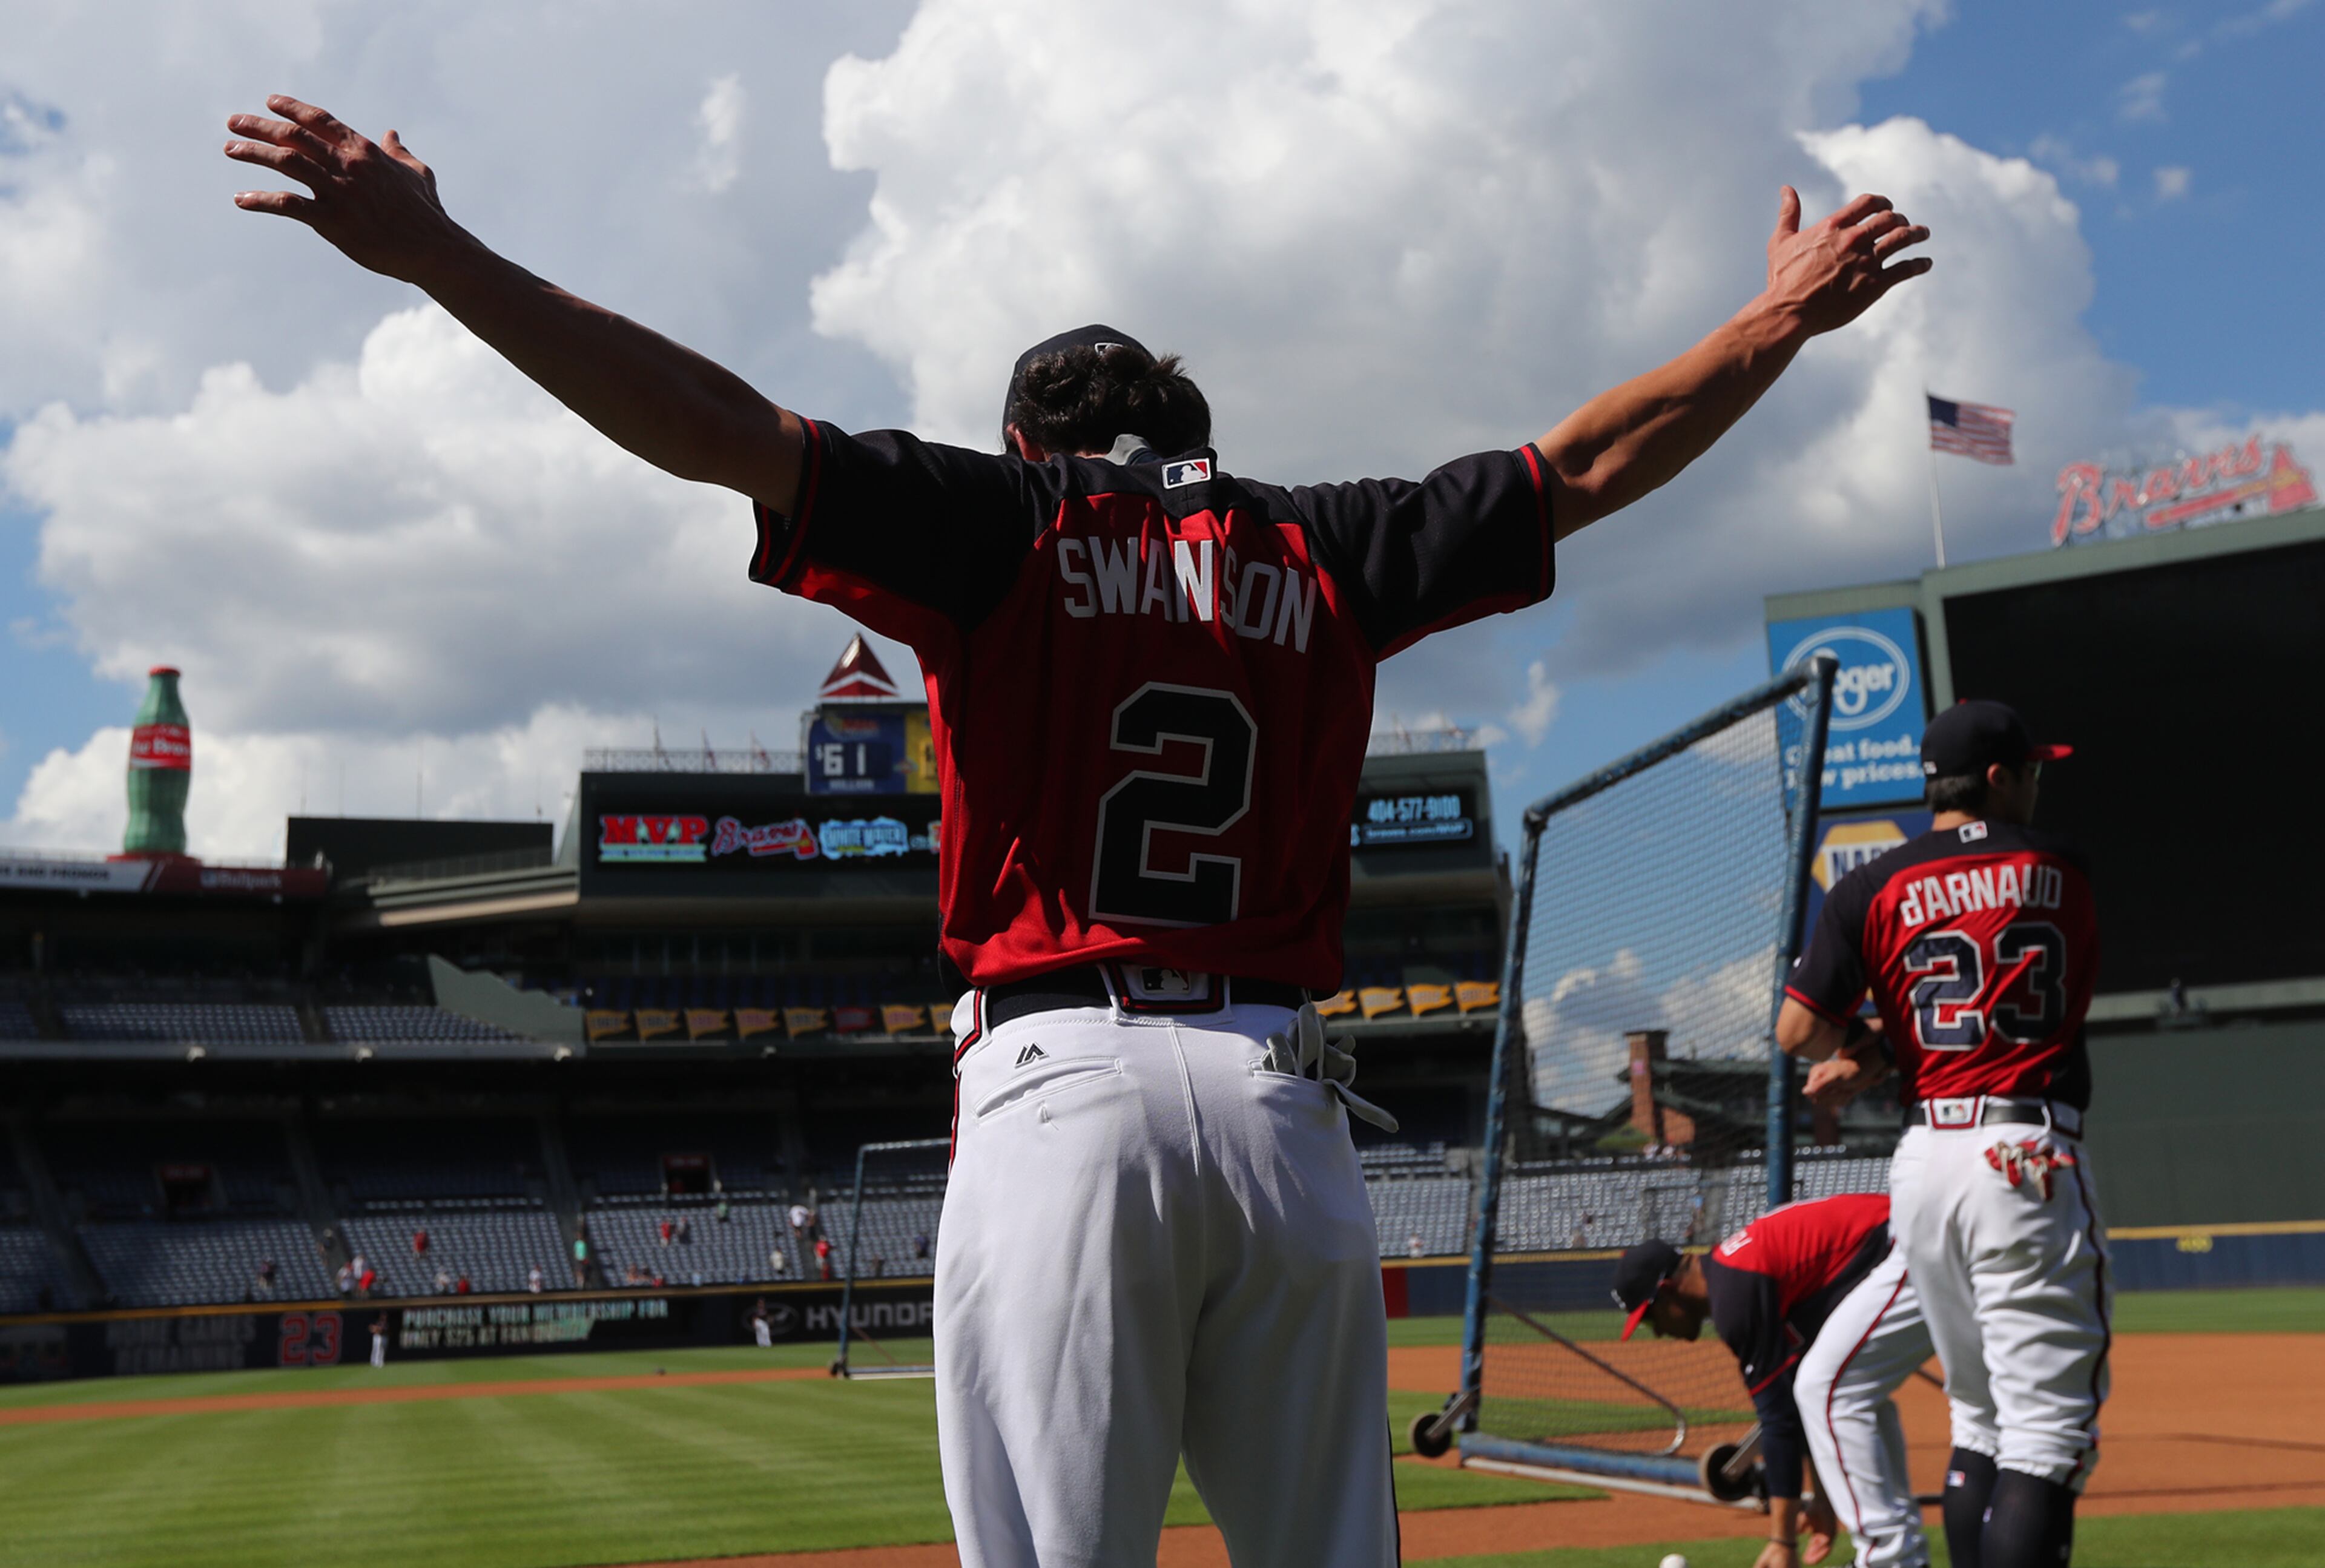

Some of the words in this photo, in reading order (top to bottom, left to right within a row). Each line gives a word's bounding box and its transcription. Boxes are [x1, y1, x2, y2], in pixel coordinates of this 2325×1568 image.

[2051, 433, 2263, 547] Braves
[1057, 536, 1317, 654] SWANSON
[1786, 742, 1855, 768] Gat
[1859, 734, 1922, 760] food.
[1786, 769, 1837, 789] lw
[1841, 760, 1925, 789] prices.
[1089, 680, 1258, 927] 2
[601, 814, 708, 844] MVP
[714, 818, 802, 854] Braves
[1901, 864, 2062, 927] d'ARNAUD
[1904, 921, 2066, 1051] 23
[403, 1306, 483, 1328] PURCHASE
[487, 1303, 530, 1325] YOUR
[533, 1300, 635, 1322] MEMBERSHIP
[638, 1299, 669, 1319] FOR
[805, 1300, 933, 1331] HYUNDA
[279, 1311, 343, 1366] 23
